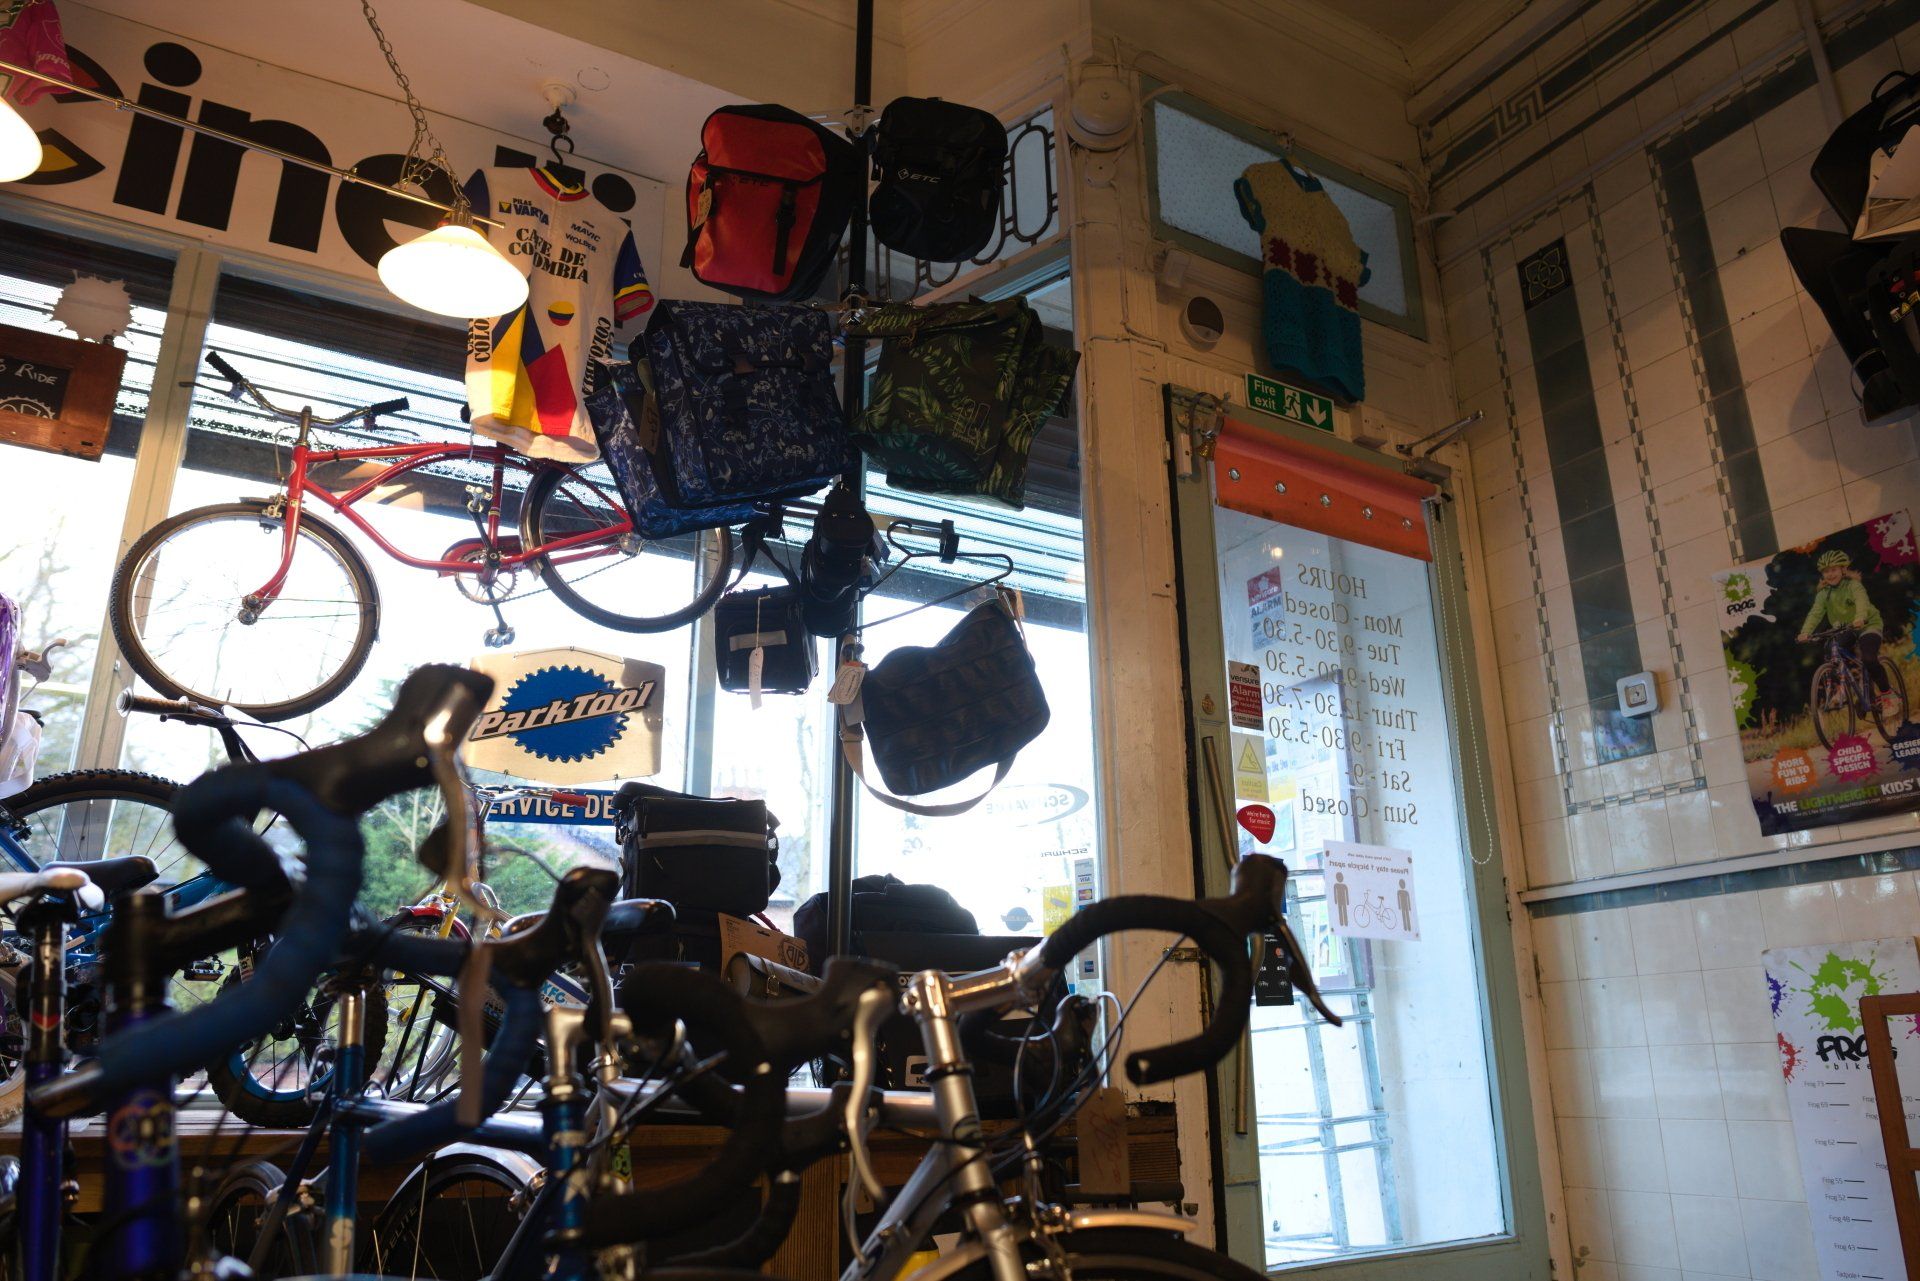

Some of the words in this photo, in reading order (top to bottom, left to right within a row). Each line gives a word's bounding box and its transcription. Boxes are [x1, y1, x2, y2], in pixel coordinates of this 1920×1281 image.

[512, 197, 532, 206] PILAS
[512, 204, 549, 225] VARTA
[571, 223, 601, 242] MAVIC
[508, 242, 589, 284] COOMBIA
[559, 247, 587, 267] DE
[15, 363, 58, 386] RIDE
[1254, 379, 1276, 396] Fire
[1254, 396, 1276, 410] exit
[1251, 597, 1281, 618] ALARM
[1232, 685, 1261, 698] Alarm
[1837, 744, 1863, 756] CHILD
[1778, 757, 1804, 769] MORE
[1833, 752, 1871, 765] SPECIFIC
[1777, 768, 1797, 779] FUN
[1798, 766, 1810, 776] TO
[1837, 760, 1871, 774] DESIGN
[1785, 775, 1807, 786] RIDE
[488, 789, 575, 818] ERVICE
[1774, 801, 1798, 814] THE
[1801, 786, 1879, 809] LIGHTWEIGHT
[1259, 811, 1270, 819] here
[1833, 1063, 1872, 1071] bike
[1804, 1080, 1817, 1088] Frog
[1808, 1101, 1820, 1109] Frog
[1825, 1193, 1837, 1201] Frog
[1834, 1243, 1847, 1251] Frog
